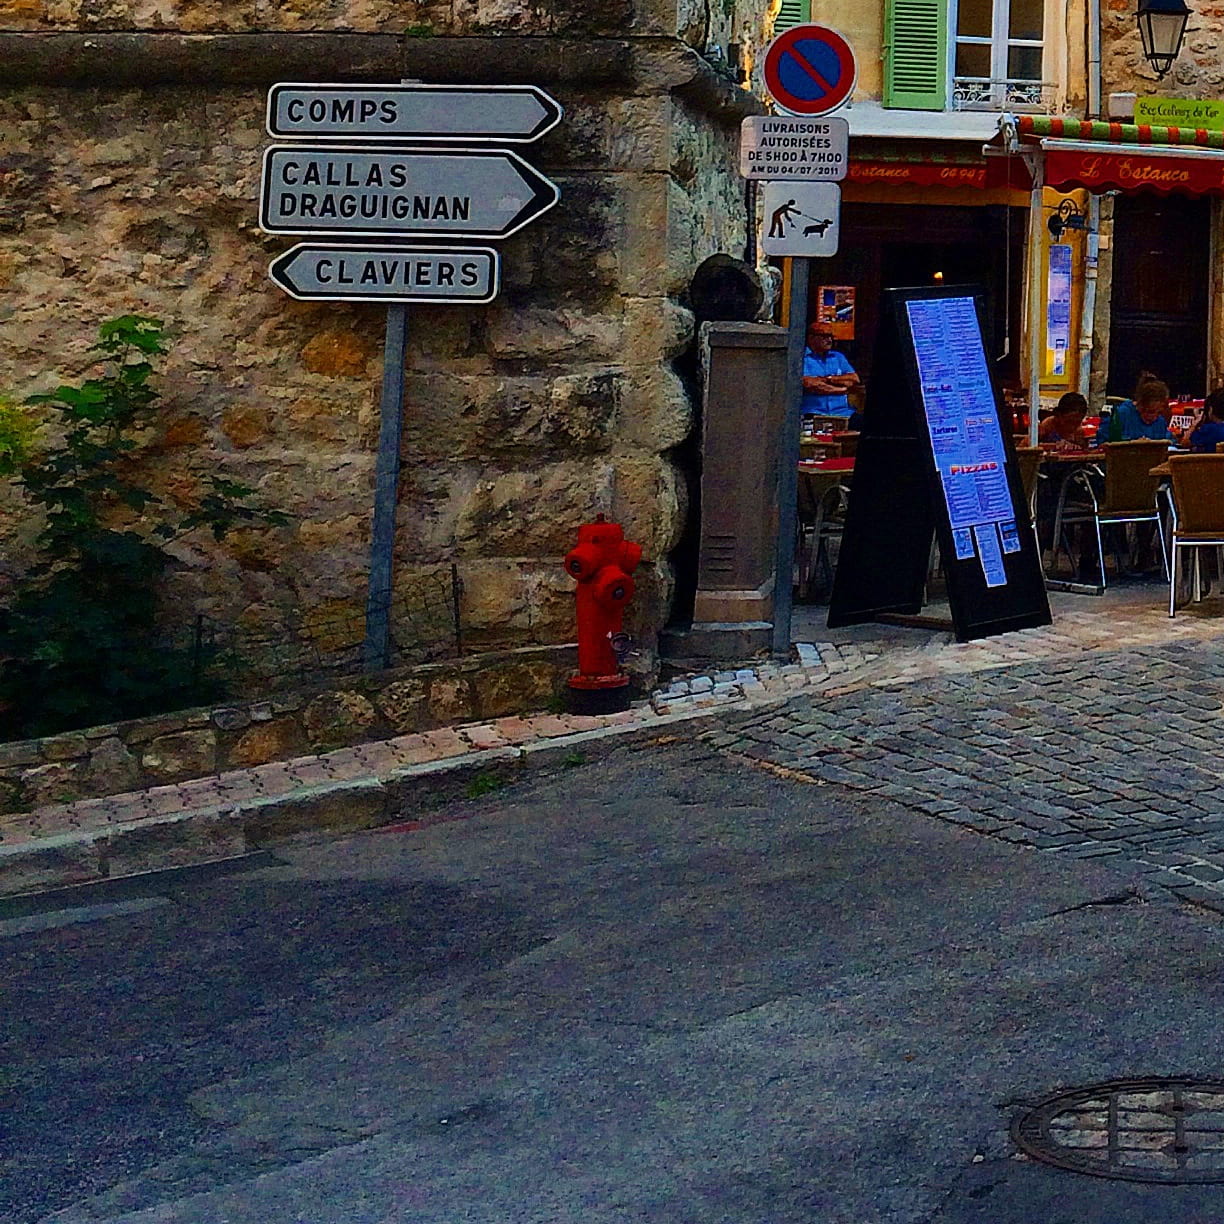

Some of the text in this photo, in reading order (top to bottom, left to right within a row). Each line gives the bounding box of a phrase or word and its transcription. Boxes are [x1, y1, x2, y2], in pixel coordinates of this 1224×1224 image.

[287, 98, 397, 124] COMPS
[762, 123, 830, 134] LIVRAISONS
[760, 136, 831, 148] AUTORISÉES
[748, 149, 842, 163] DE 5H00 À 7H00
[282, 162, 407, 188] CALLAS
[767, 166, 779, 174] DU
[781, 166, 839, 175] 04/07/2011
[1117, 158, 1190, 182] Estanco
[279, 193, 471, 221] DRAGUIGNAN
[316, 259, 478, 286] CLAVIERS
